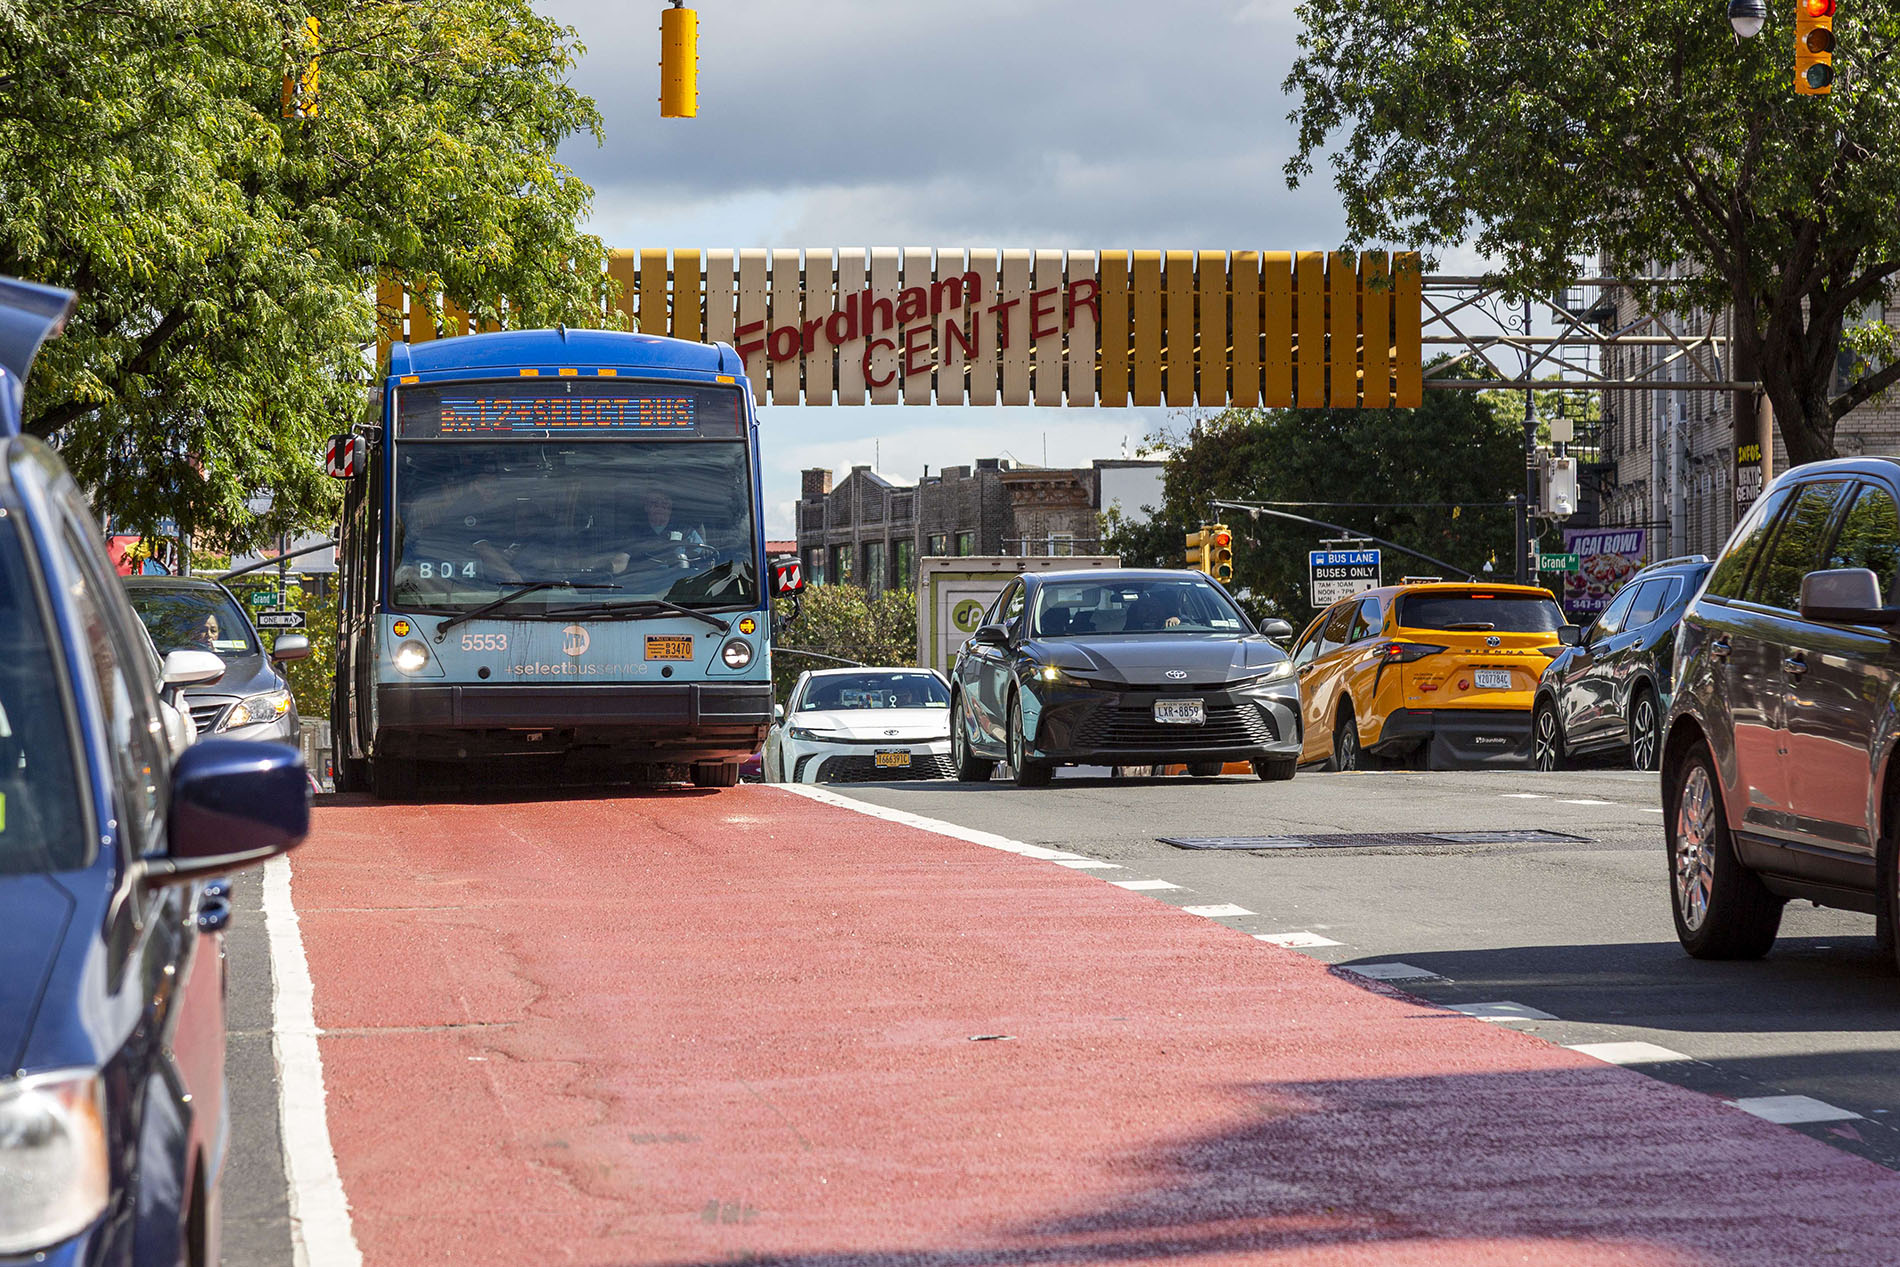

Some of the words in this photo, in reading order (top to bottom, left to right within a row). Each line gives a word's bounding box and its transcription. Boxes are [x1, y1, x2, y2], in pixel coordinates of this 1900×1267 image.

[735, 272, 981, 371] Fordham
[863, 279, 1099, 387] CENTER
[641, 400, 688, 426] BUS
[1603, 533, 1638, 554] BOWL
[1328, 554, 1346, 563] BUS
[1350, 553, 1374, 563] LANE
[1541, 556, 1566, 568] Grand
[420, 562, 476, 578] 804
[1317, 568, 1347, 578] BUSES
[1350, 567, 1374, 577] ONLY
[253, 594, 270, 604] Grand
[263, 616, 277, 624] ONE
[461, 634, 508, 650] 5553
[563, 629, 588, 652] MTA
[1158, 706, 1174, 717] LXR
[1178, 705, 1199, 717] 8859
